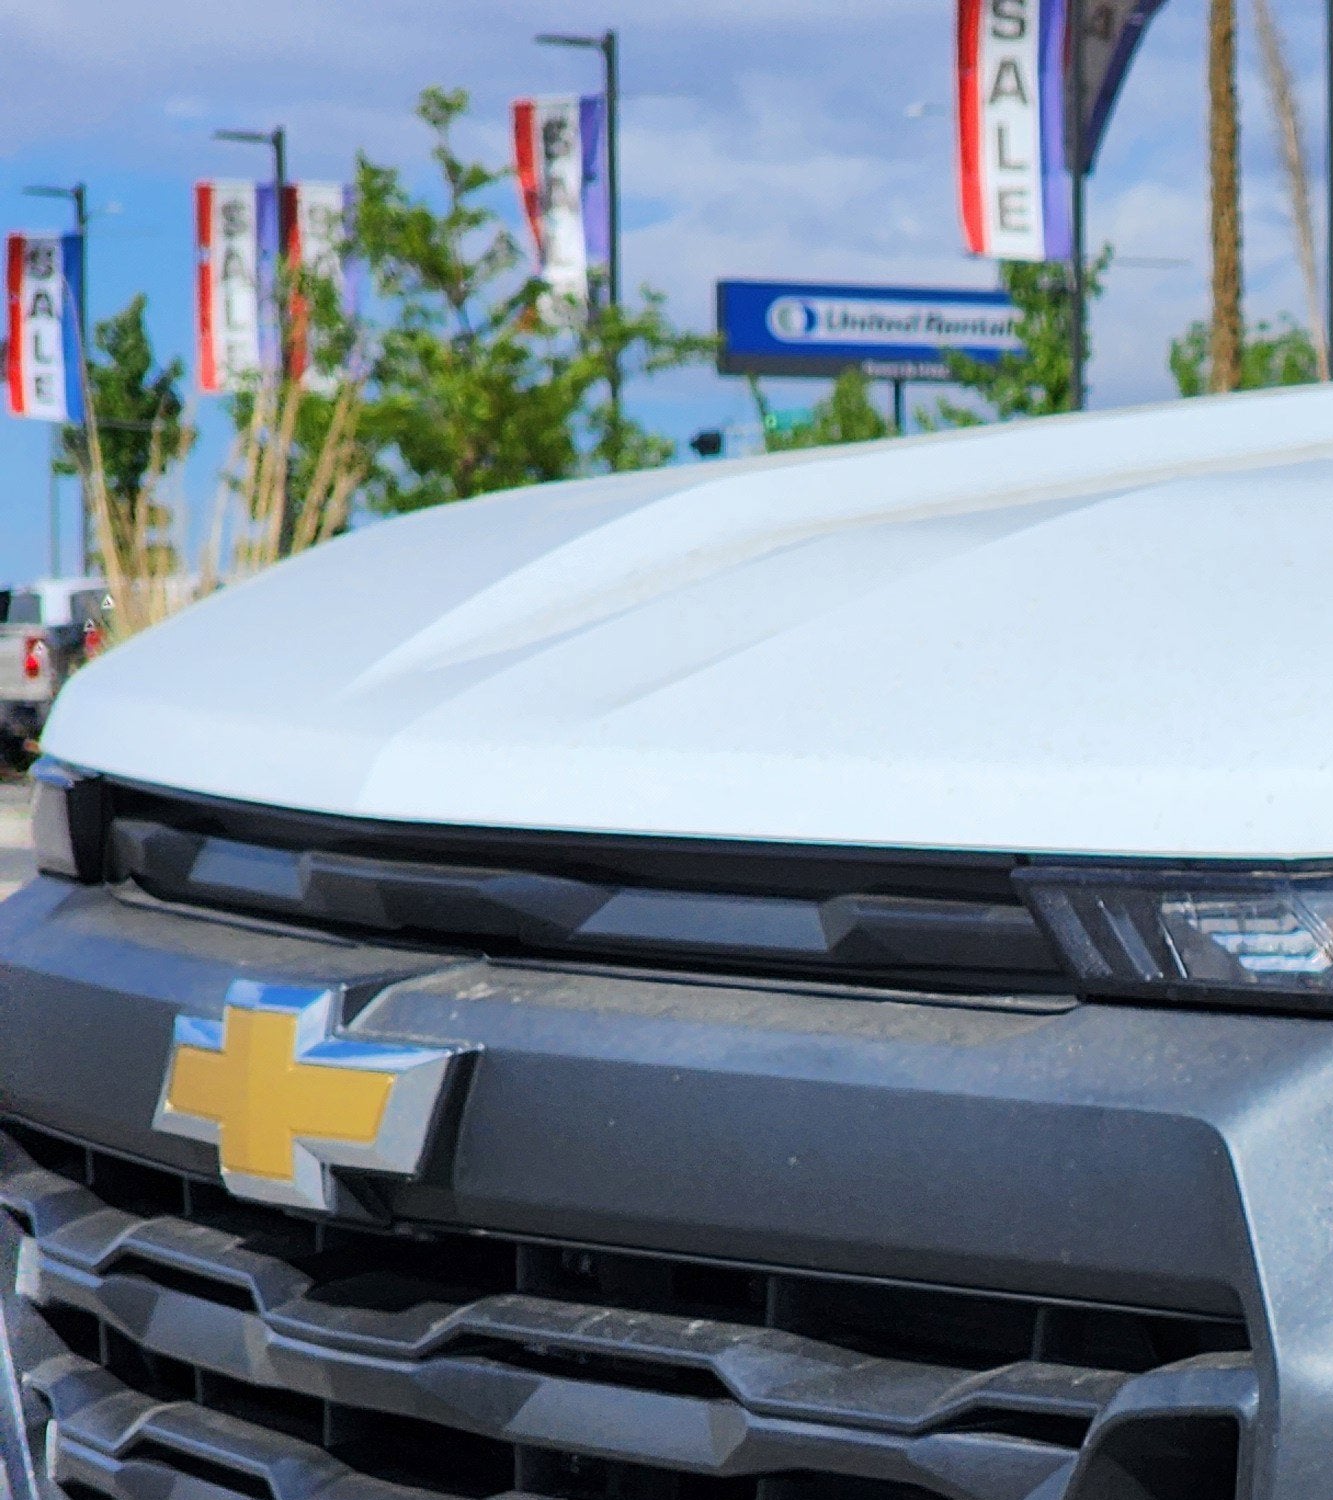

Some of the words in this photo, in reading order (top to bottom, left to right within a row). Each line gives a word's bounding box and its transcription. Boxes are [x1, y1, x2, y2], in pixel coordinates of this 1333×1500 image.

[990, 0, 1029, 232] SALE
[29, 246, 56, 406] SALE
[825, 307, 921, 332] United
[925, 311, 1015, 336] Rental
